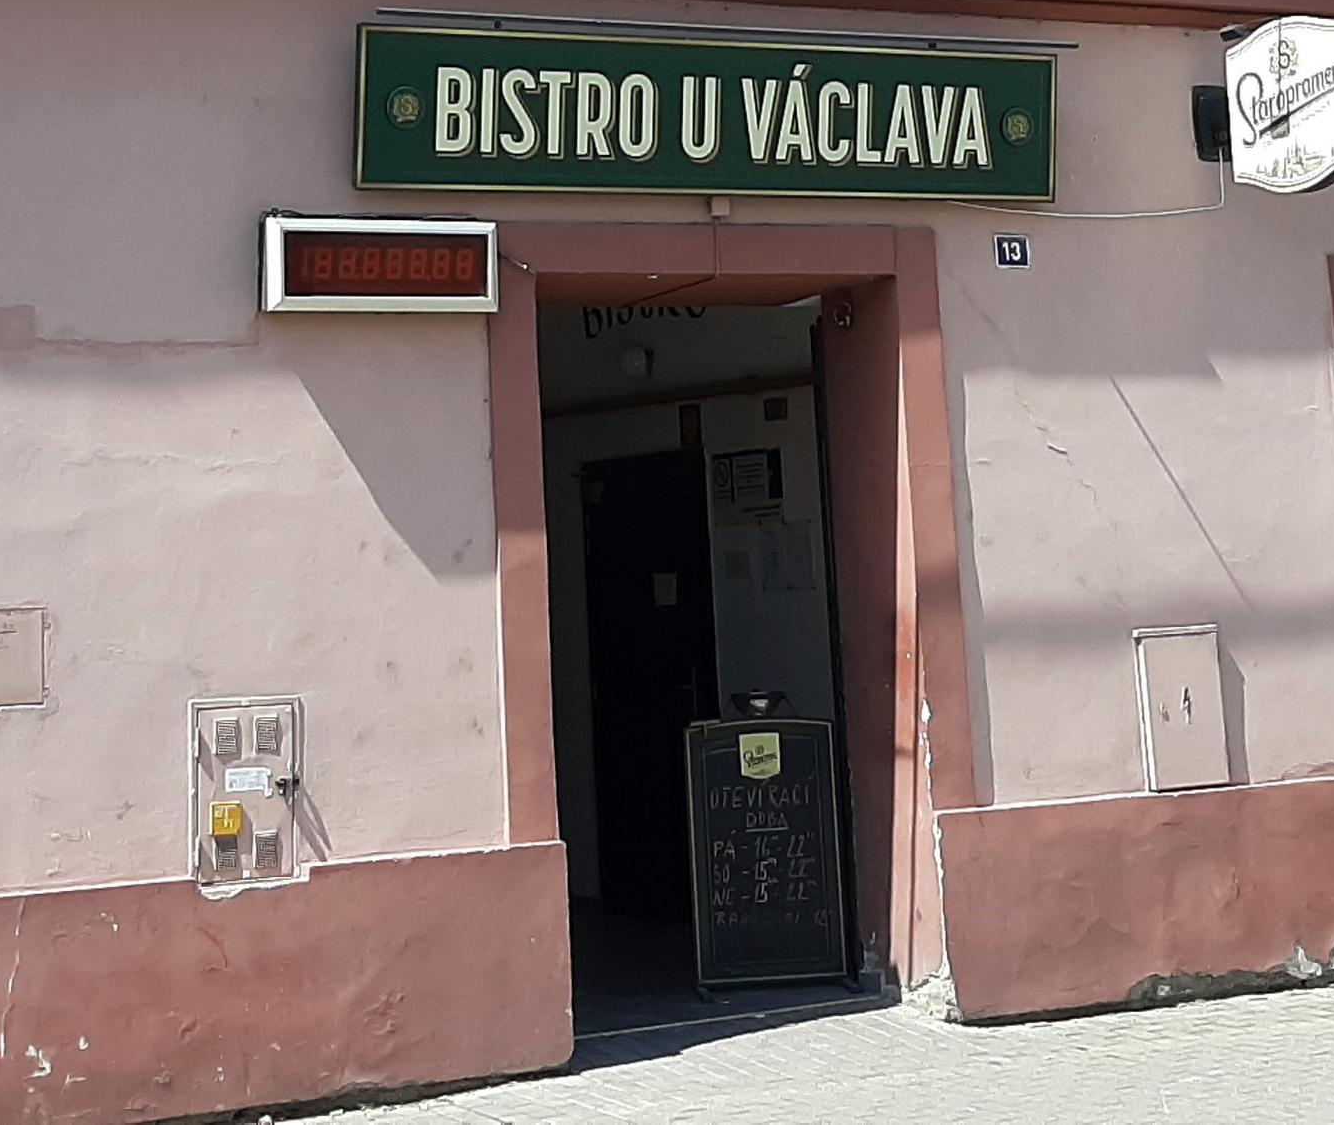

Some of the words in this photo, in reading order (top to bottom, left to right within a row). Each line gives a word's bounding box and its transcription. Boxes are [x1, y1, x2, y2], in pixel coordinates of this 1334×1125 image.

[435, 67, 658, 162] BISTRO
[681, 76, 721, 163] U
[741, 64, 993, 169] VÁCLAVA
[1002, 241, 1021, 261] 13
